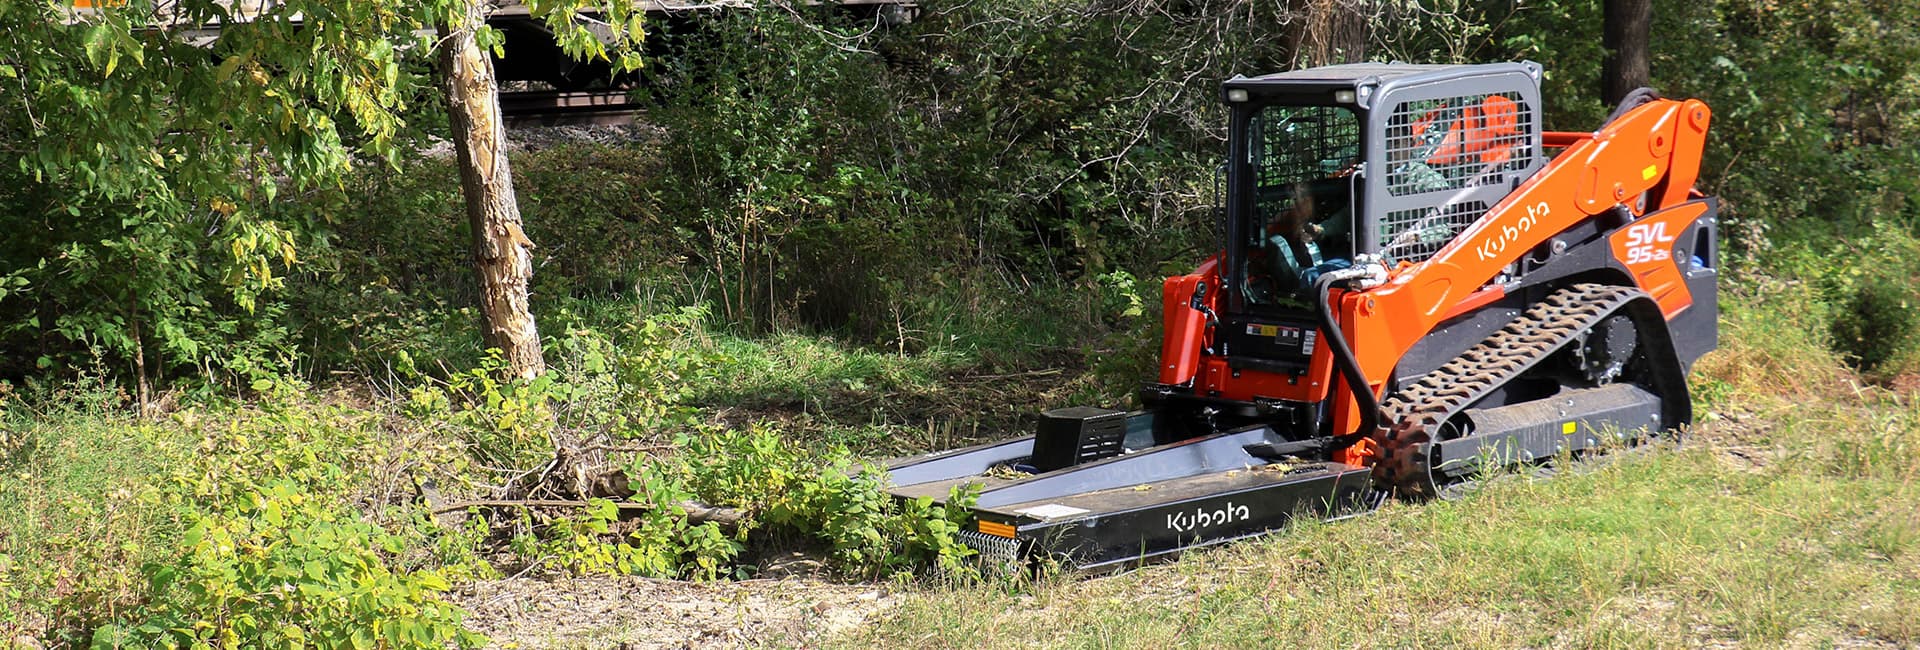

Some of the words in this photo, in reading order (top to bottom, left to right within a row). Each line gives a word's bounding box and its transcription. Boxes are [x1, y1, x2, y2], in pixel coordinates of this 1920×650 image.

[1476, 201, 1550, 261] Kubota
[1625, 222, 1673, 247] SVL
[1167, 501, 1249, 532] Kubota
